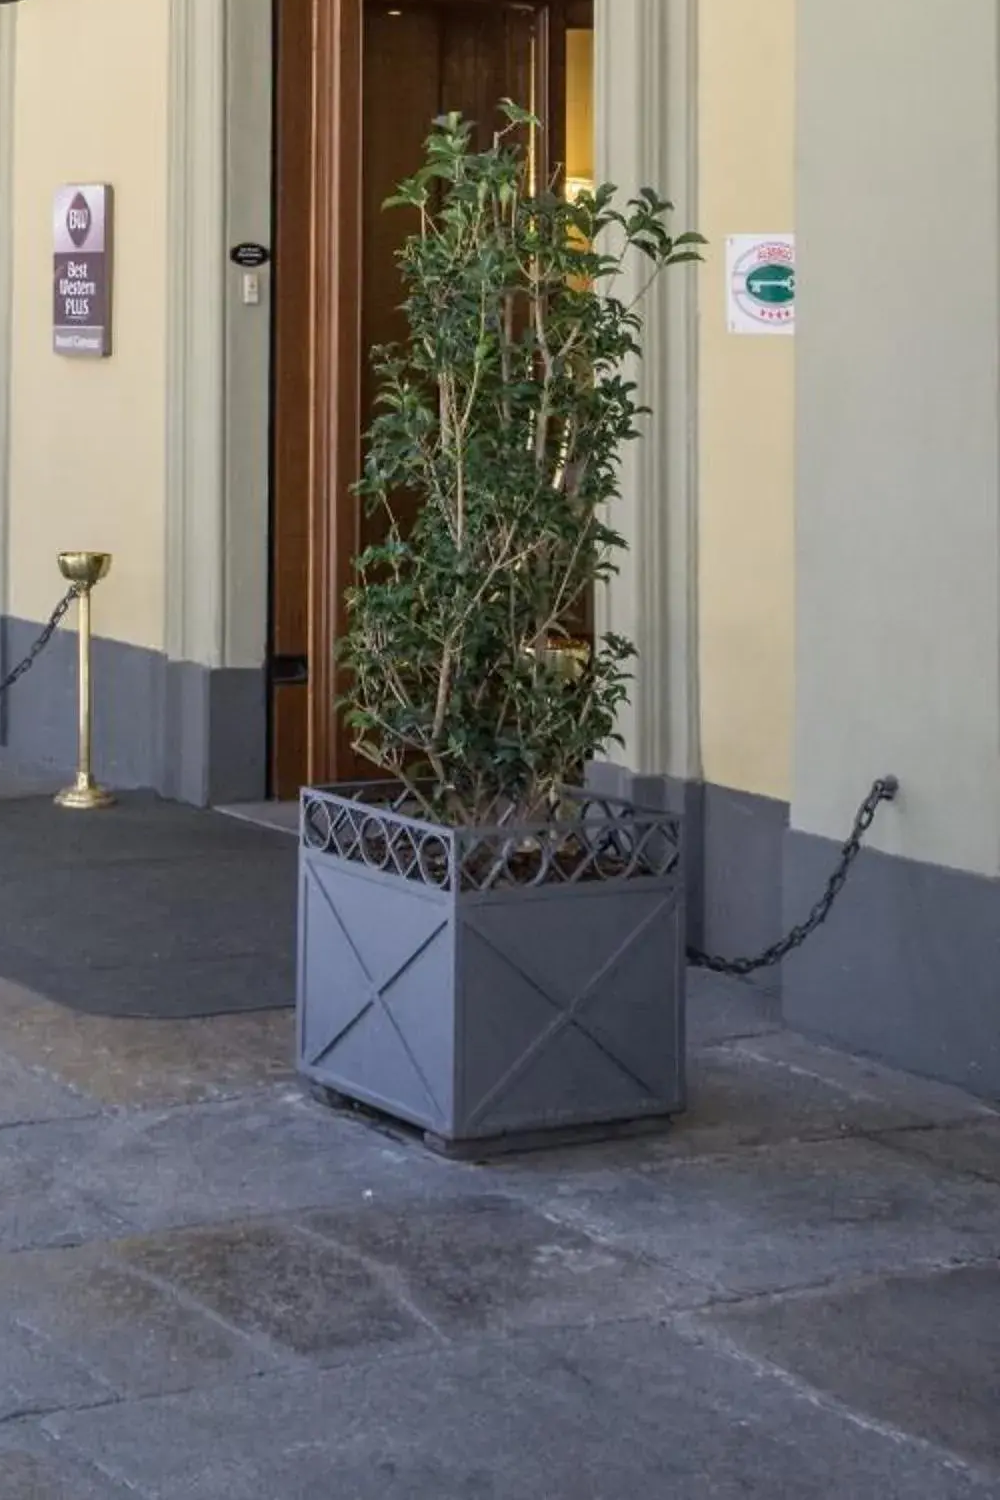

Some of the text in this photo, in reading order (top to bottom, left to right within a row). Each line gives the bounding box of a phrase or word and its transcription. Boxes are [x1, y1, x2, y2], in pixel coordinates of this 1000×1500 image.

[67, 261, 88, 278] Best
[59, 280, 96, 297] Western
[65, 299, 89, 315] PLUS
